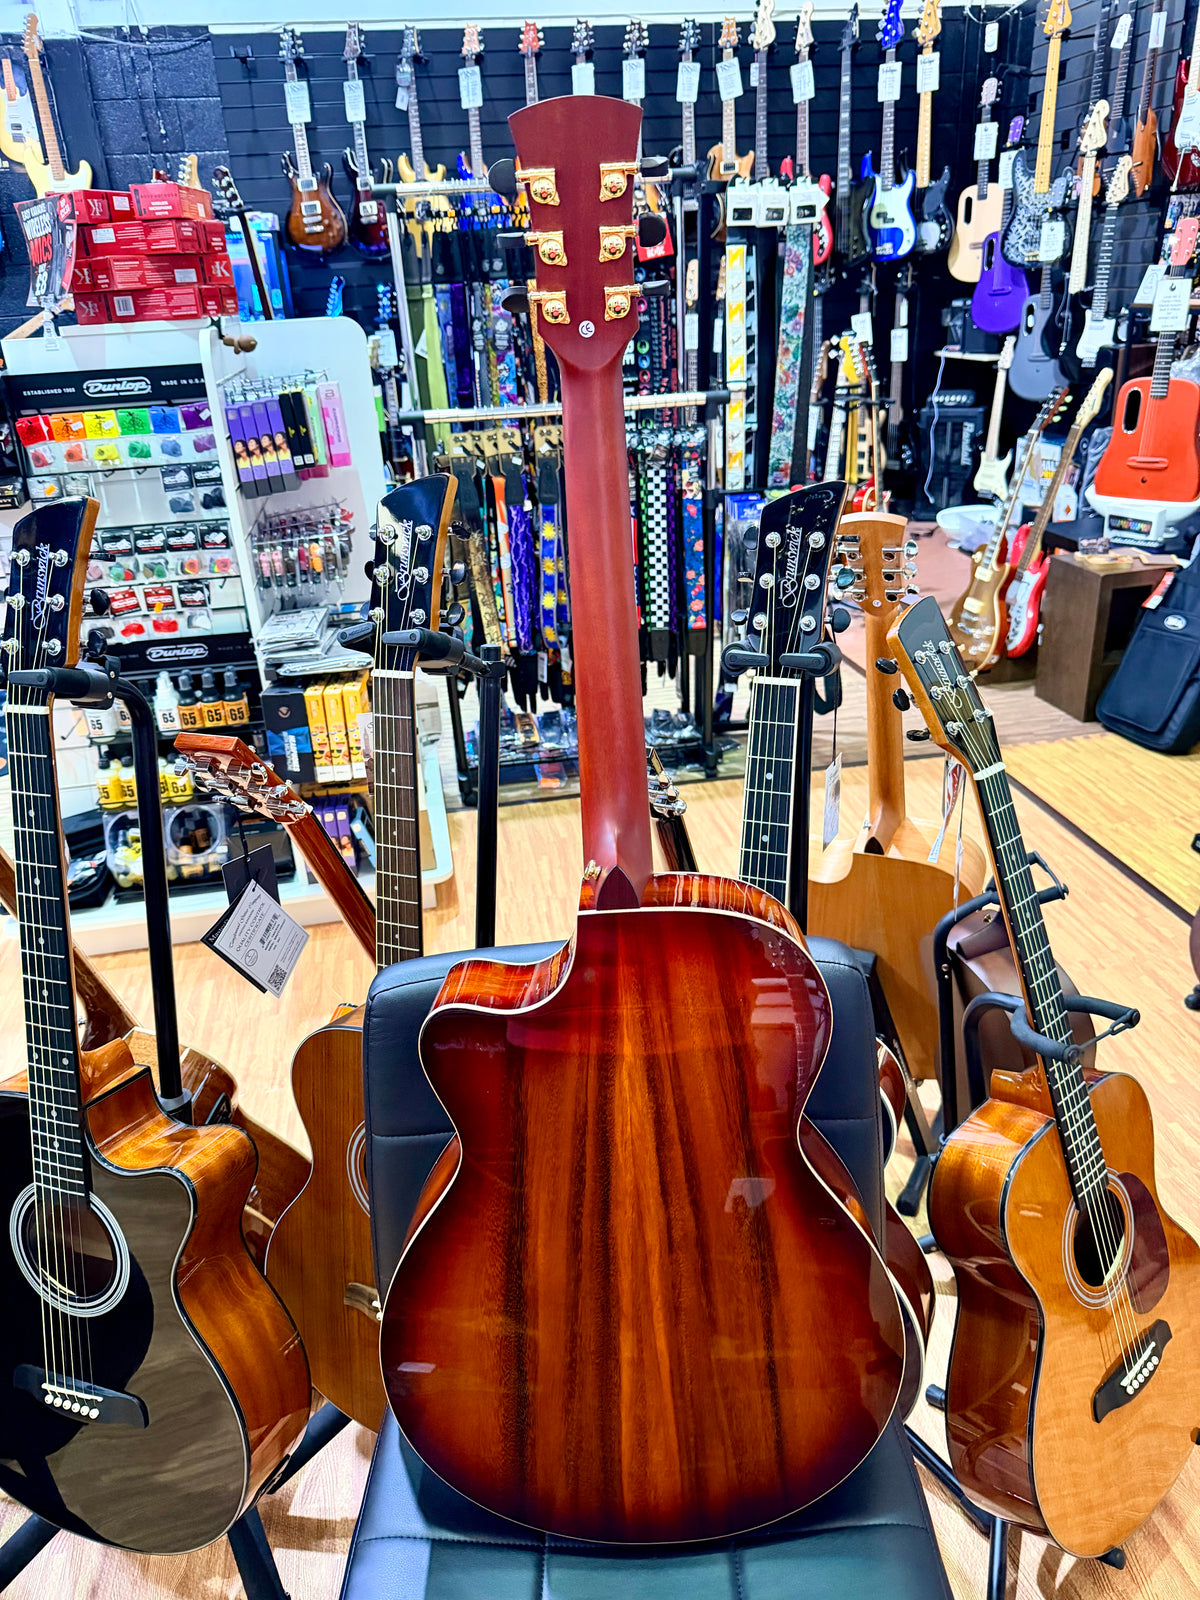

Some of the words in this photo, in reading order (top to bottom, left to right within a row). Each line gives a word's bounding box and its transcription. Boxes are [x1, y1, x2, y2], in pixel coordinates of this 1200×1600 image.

[23, 212, 52, 240] WIRELESS
[30, 233, 52, 267] MICS
[35, 271, 48, 296] £8
[23, 388, 62, 396] ESTABLISHED
[87, 379, 149, 394] Dunlop
[960, 421, 975, 466] Randall
[394, 519, 413, 600] Brunswick
[778, 525, 802, 608] Brunswick
[30, 542, 50, 630] Brunswick
[149, 645, 207, 660] Dunlop
[922, 640, 963, 709] Brunswick
[91, 719, 103, 730] 65
[162, 712, 175, 723] 65
[182, 712, 197, 725] 65
[207, 710, 222, 723] 65
[229, 707, 245, 721] 65
[236, 927, 251, 951] QUALITY
[250, 902, 265, 927] CONTROL
[244, 913, 264, 947] CERTIFICATE
